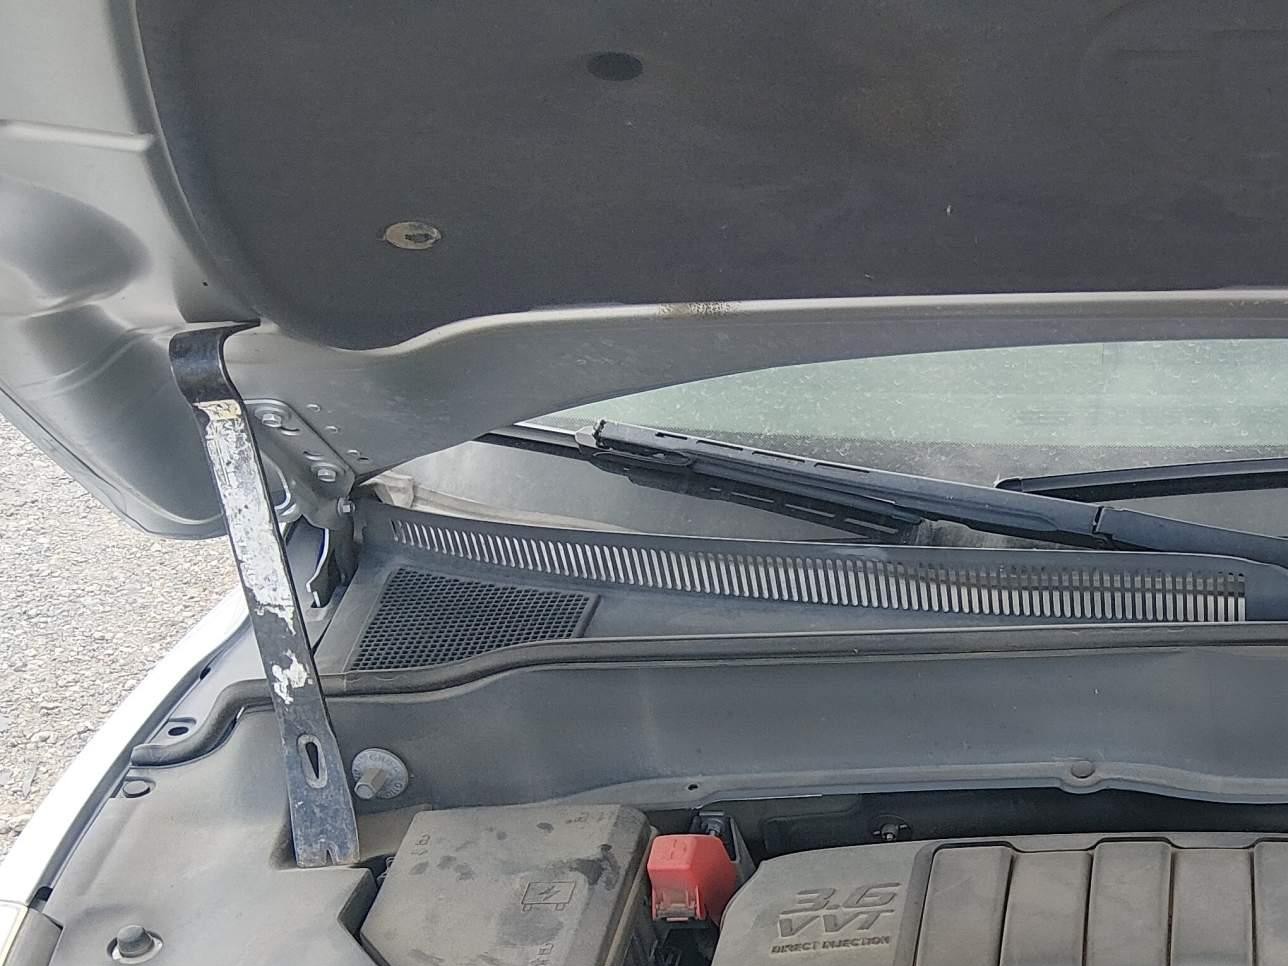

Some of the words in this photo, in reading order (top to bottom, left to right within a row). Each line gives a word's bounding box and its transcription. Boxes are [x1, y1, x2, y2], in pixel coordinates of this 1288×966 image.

[780, 882, 902, 915] 3.6
[779, 909, 895, 938] VVT
[771, 941, 821, 954] DIRECT
[822, 935, 890, 949] INJECTION
